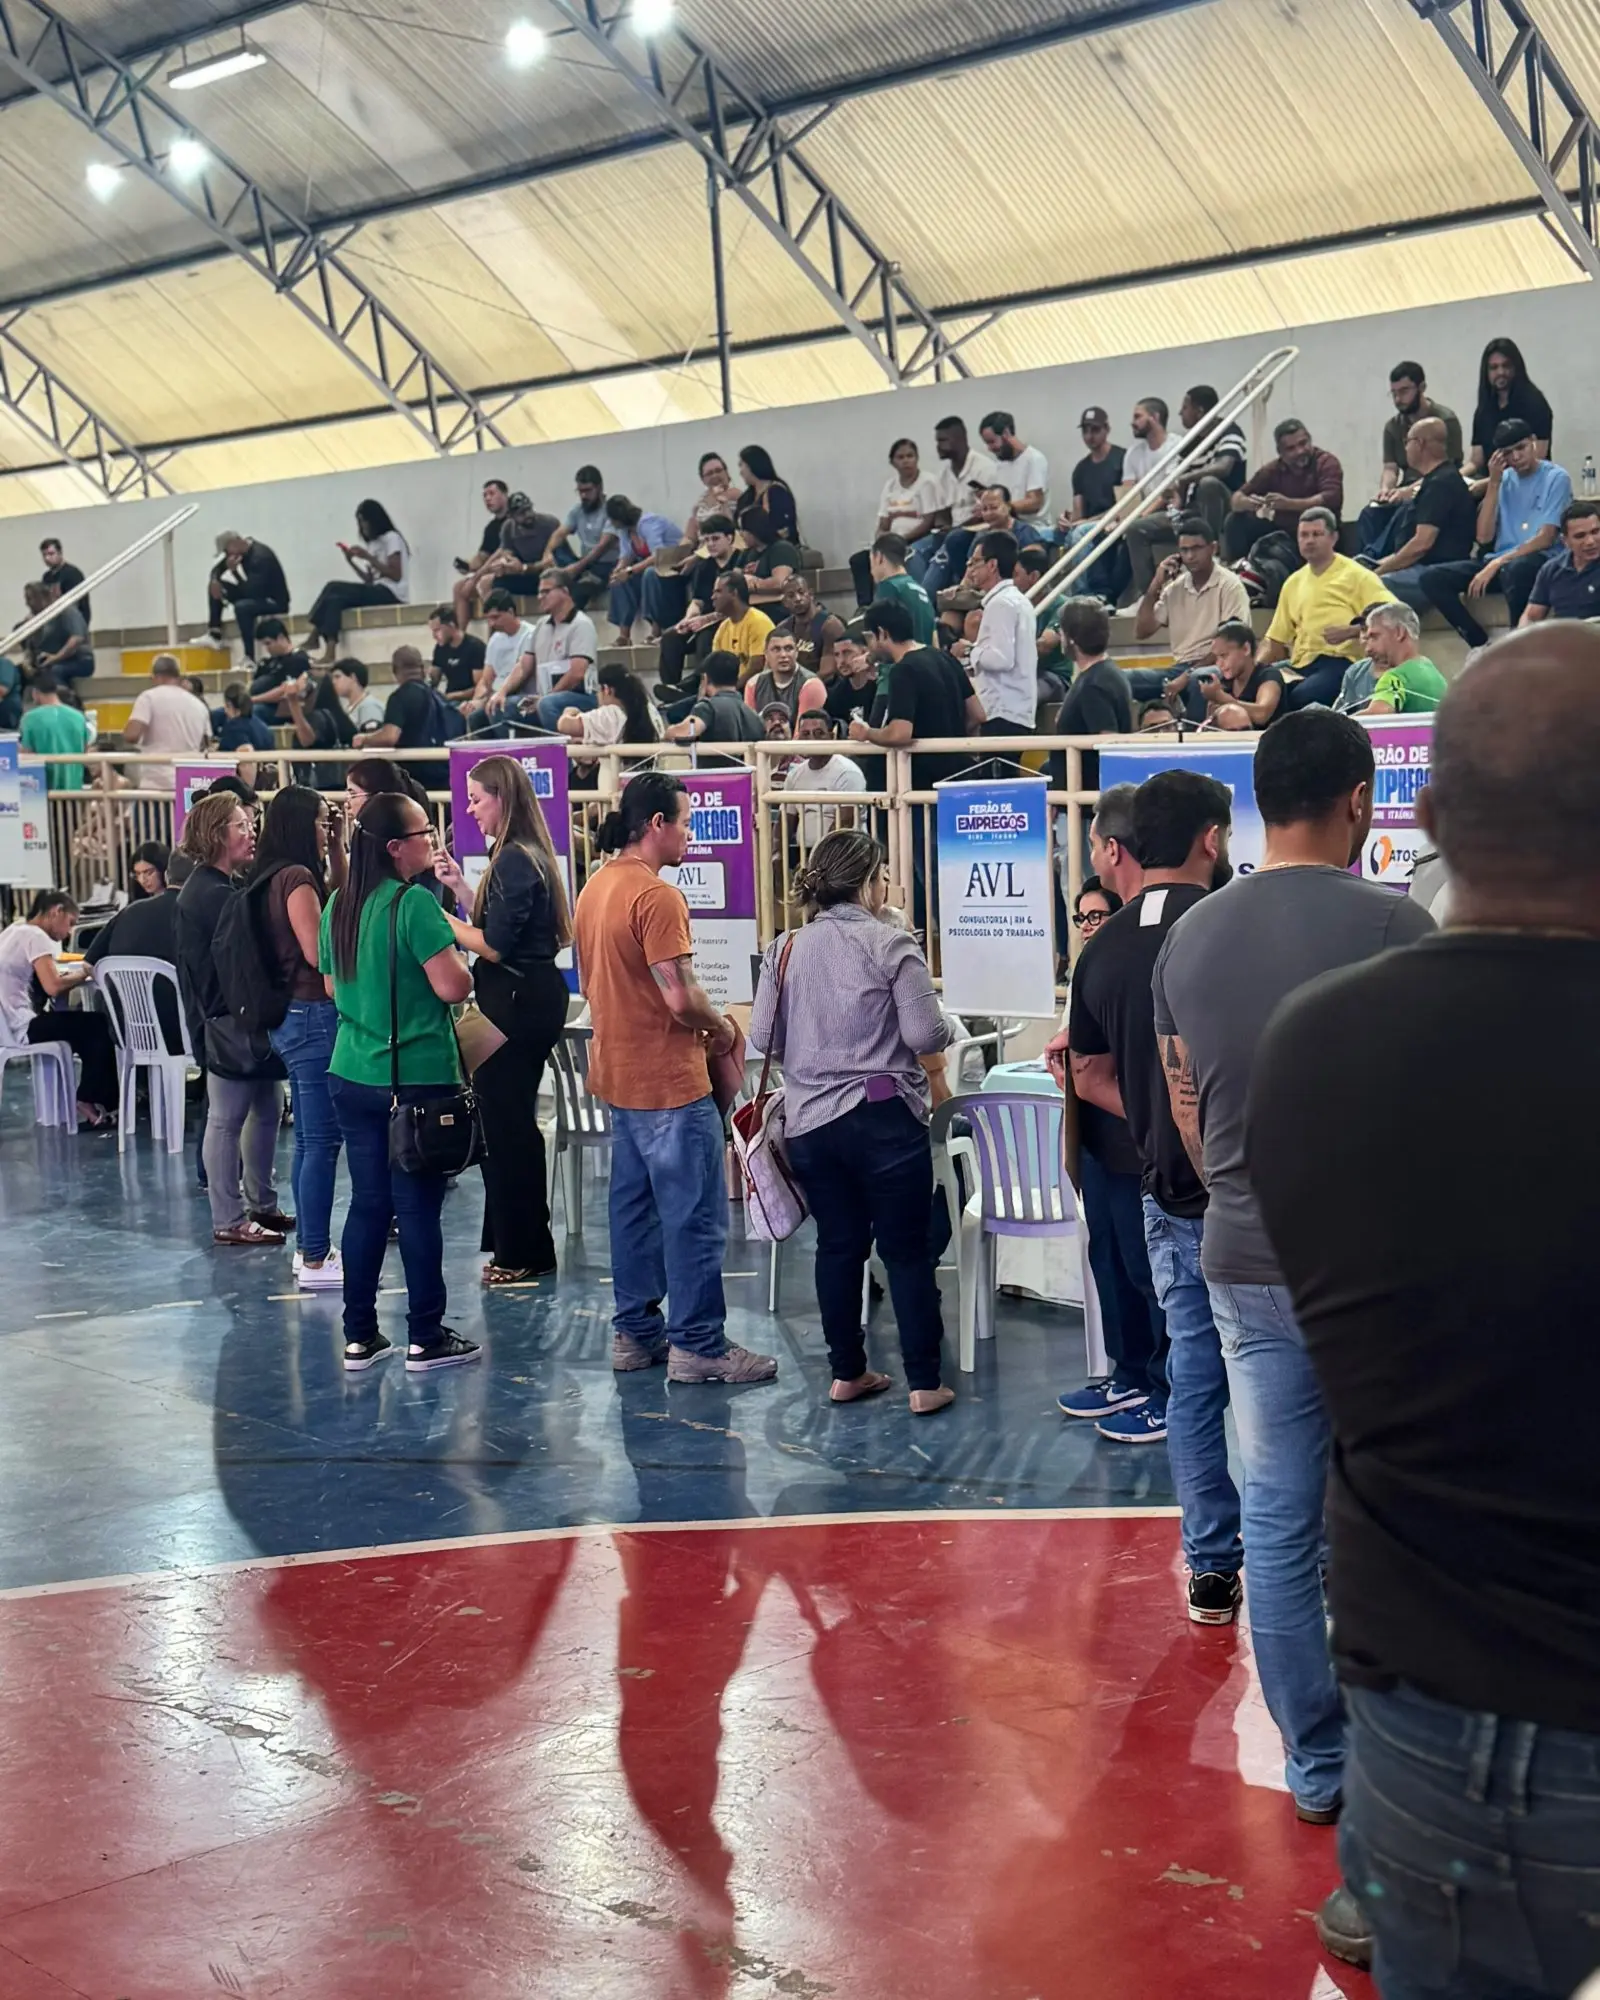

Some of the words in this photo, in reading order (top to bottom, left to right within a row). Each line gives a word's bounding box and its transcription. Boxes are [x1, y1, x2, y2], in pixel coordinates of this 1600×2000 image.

[1409, 746, 1429, 763] DE
[704, 791, 723, 806] DE
[969, 801, 999, 814] FEIRÃO
[1001, 803, 1013, 812] DE
[958, 815, 1026, 831] EMPREGOS
[677, 867, 707, 886] AVL
[965, 862, 1025, 897] AVL
[959, 915, 1008, 924] CONSULTORIA
[949, 928, 991, 937] PSICOLOGIA
[993, 929, 1004, 937] DO
[1006, 929, 1045, 937] TRABALHO
